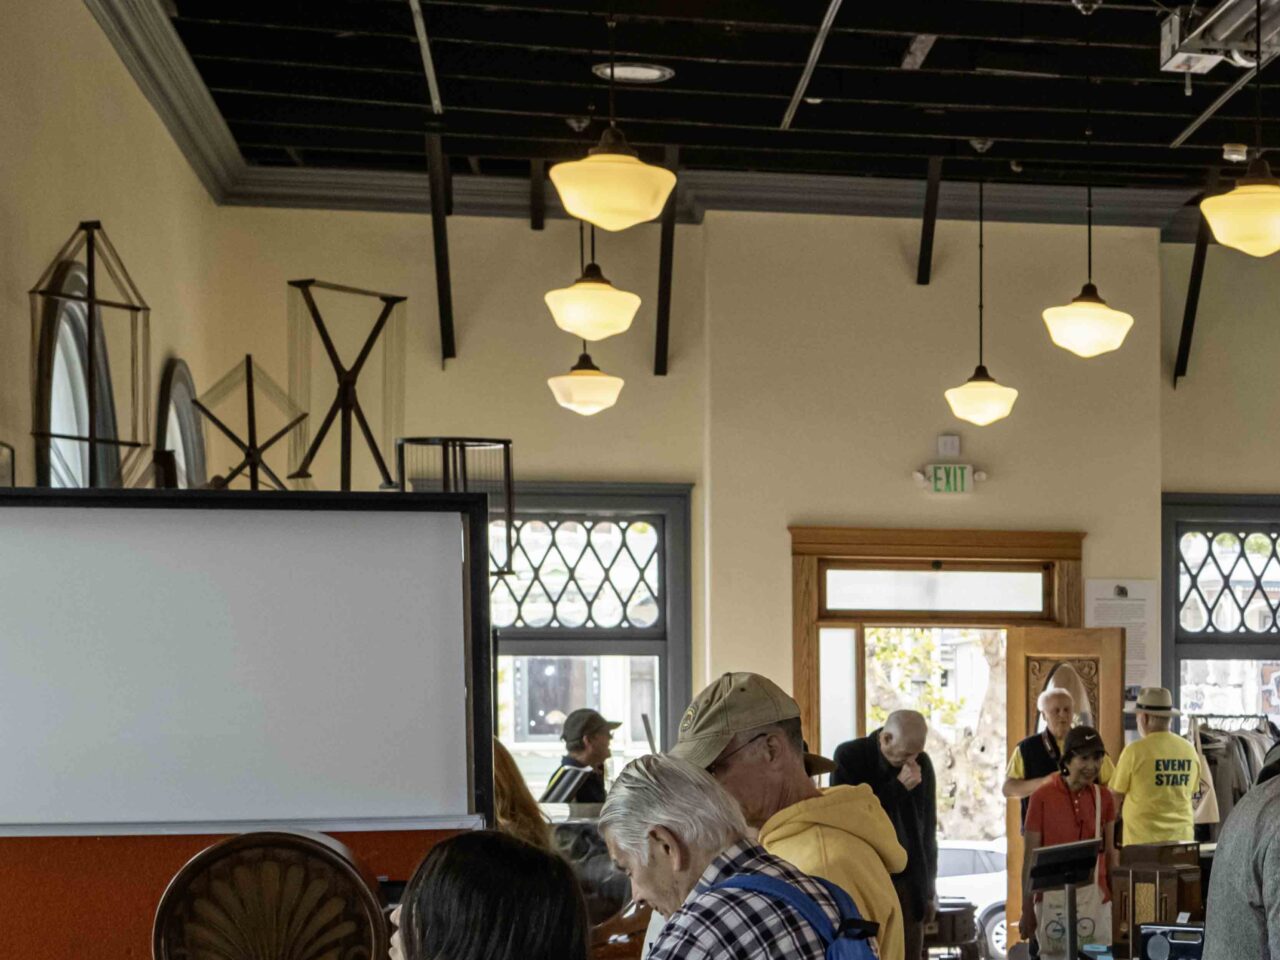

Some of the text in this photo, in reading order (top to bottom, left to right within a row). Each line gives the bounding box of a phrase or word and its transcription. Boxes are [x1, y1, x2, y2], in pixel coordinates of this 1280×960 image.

[933, 465, 967, 492] EXIT
[1155, 759, 1192, 771] EVENT
[1155, 773, 1190, 786] STAFF
